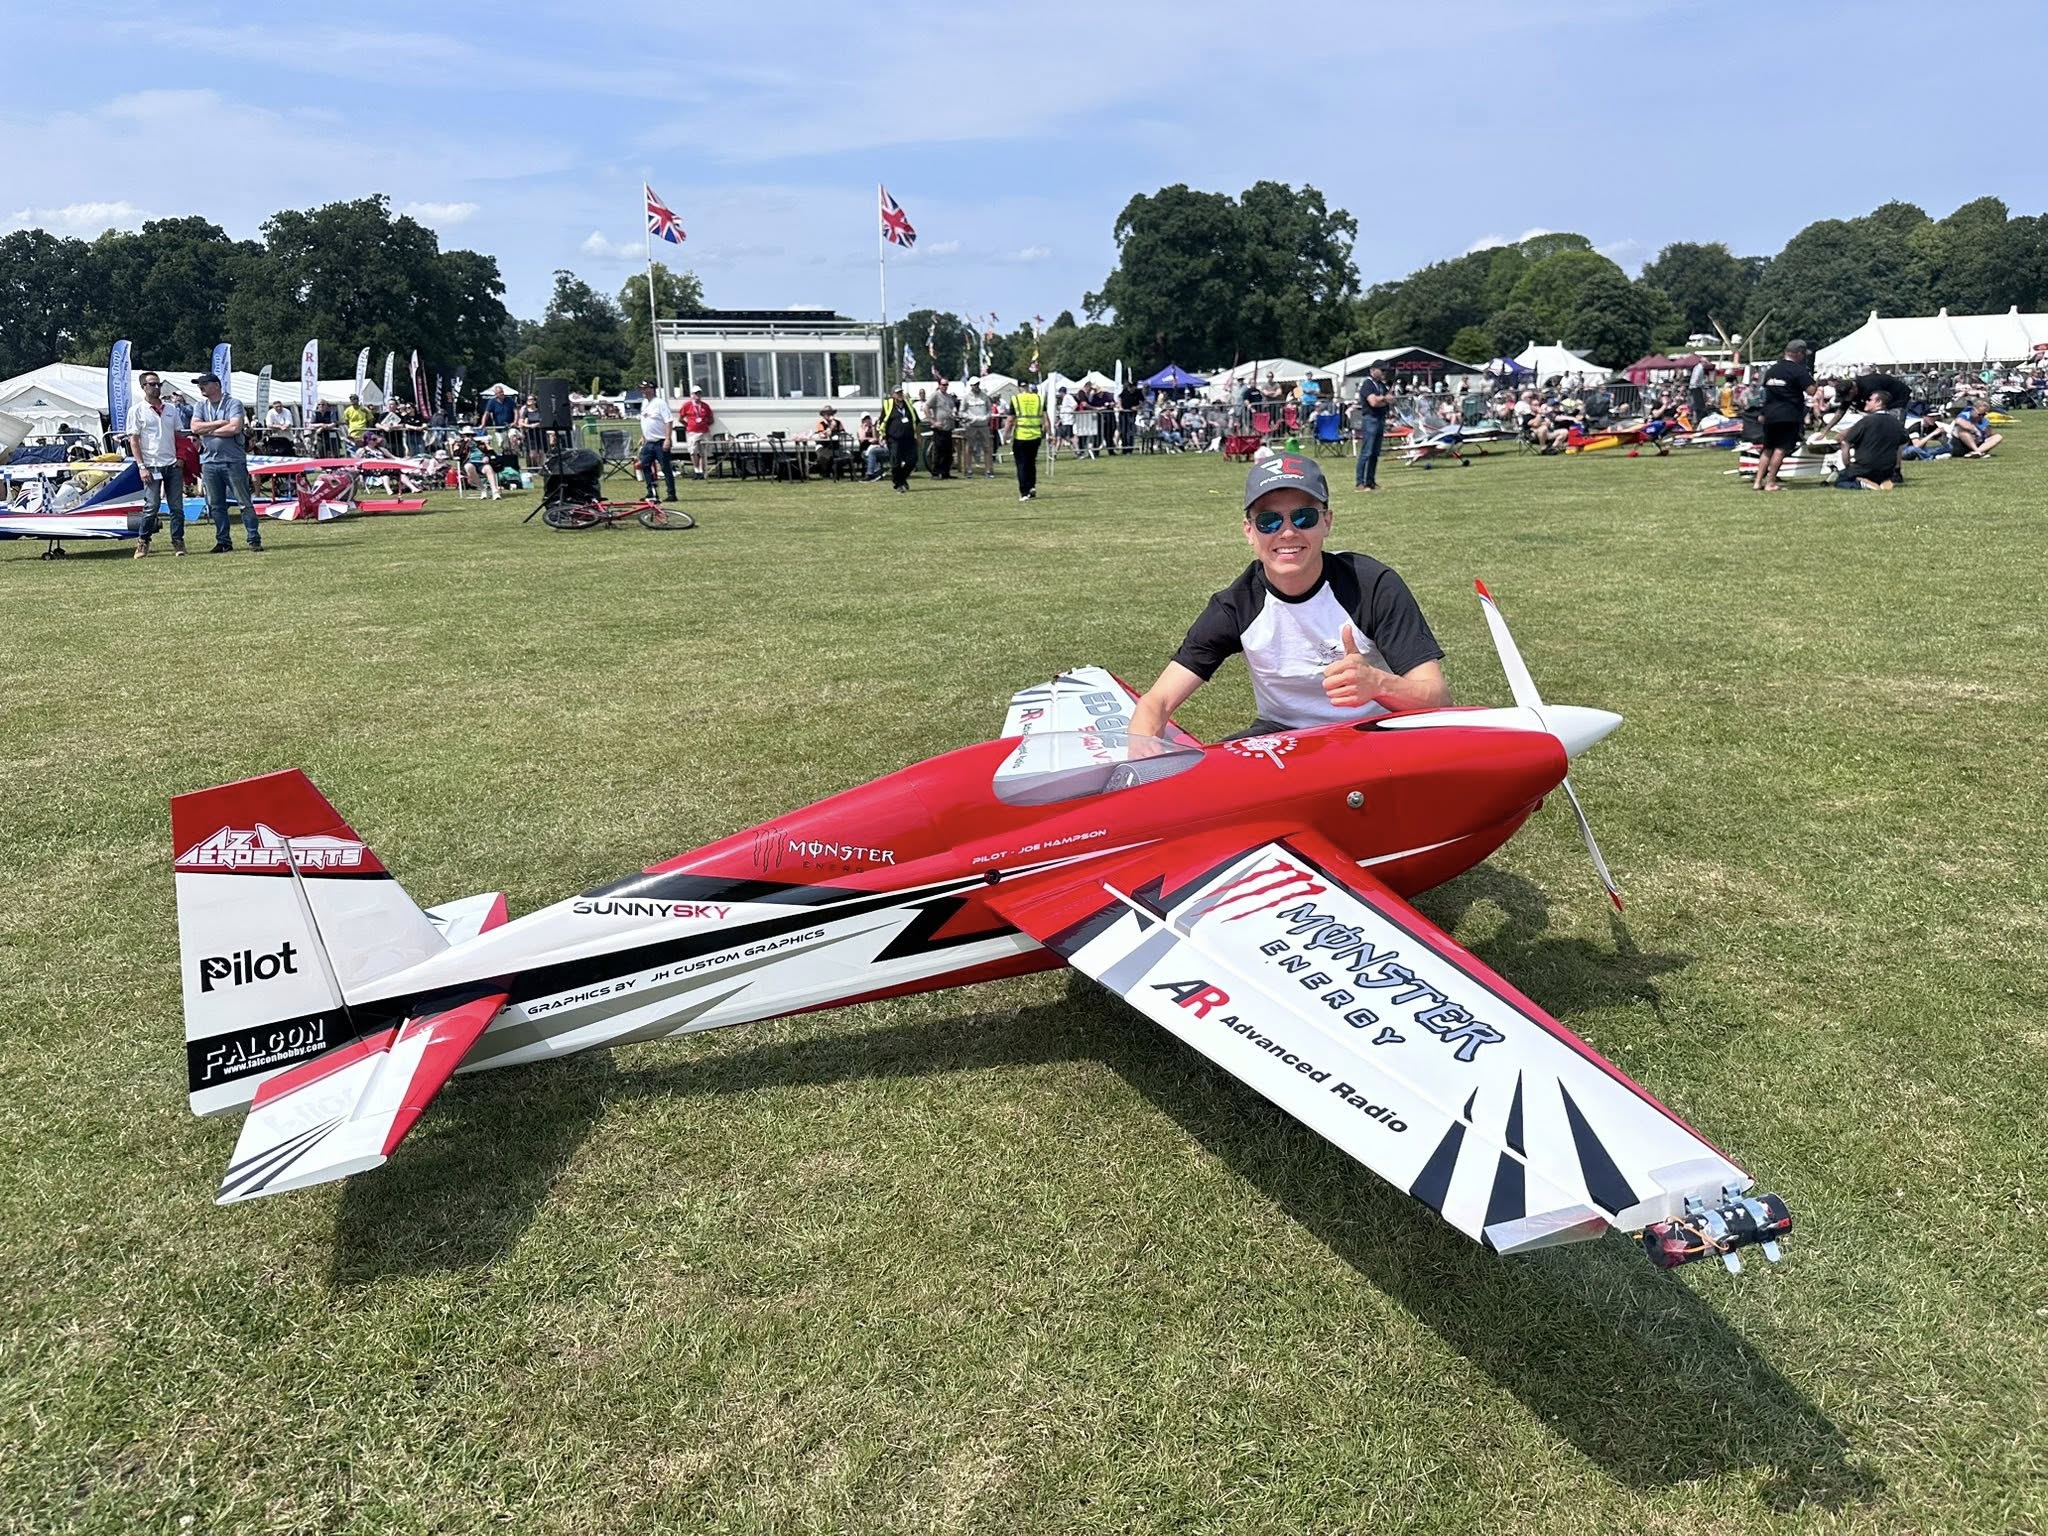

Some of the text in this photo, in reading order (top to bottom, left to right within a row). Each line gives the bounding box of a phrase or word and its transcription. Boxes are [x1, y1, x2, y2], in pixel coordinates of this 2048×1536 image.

[1260, 457, 1305, 475] RC
[1260, 473, 1305, 486] FACTORY
[198, 825, 257, 850] AZ
[788, 839, 896, 865] MONSTER
[972, 850, 1008, 864] PILOT
[1018, 843, 1041, 854] JOE
[1043, 829, 1107, 848] HAMPSON
[175, 844, 363, 869] AEROSPORTS
[802, 861, 865, 873] ENERG
[573, 901, 732, 920] SUNNYSKY
[200, 941, 298, 993] Pilot
[527, 929, 826, 1015] GRAPHICS BY JH CUSTOM GRAPHICS
[1276, 903, 1505, 1062] MONSTER
[1259, 939, 1406, 1046] ENERGY
[201, 1018, 324, 1080] FALCON
[223, 1041, 327, 1075] www.falconhobby.com
[1150, 979, 1408, 1133] AR Advanced Radio
